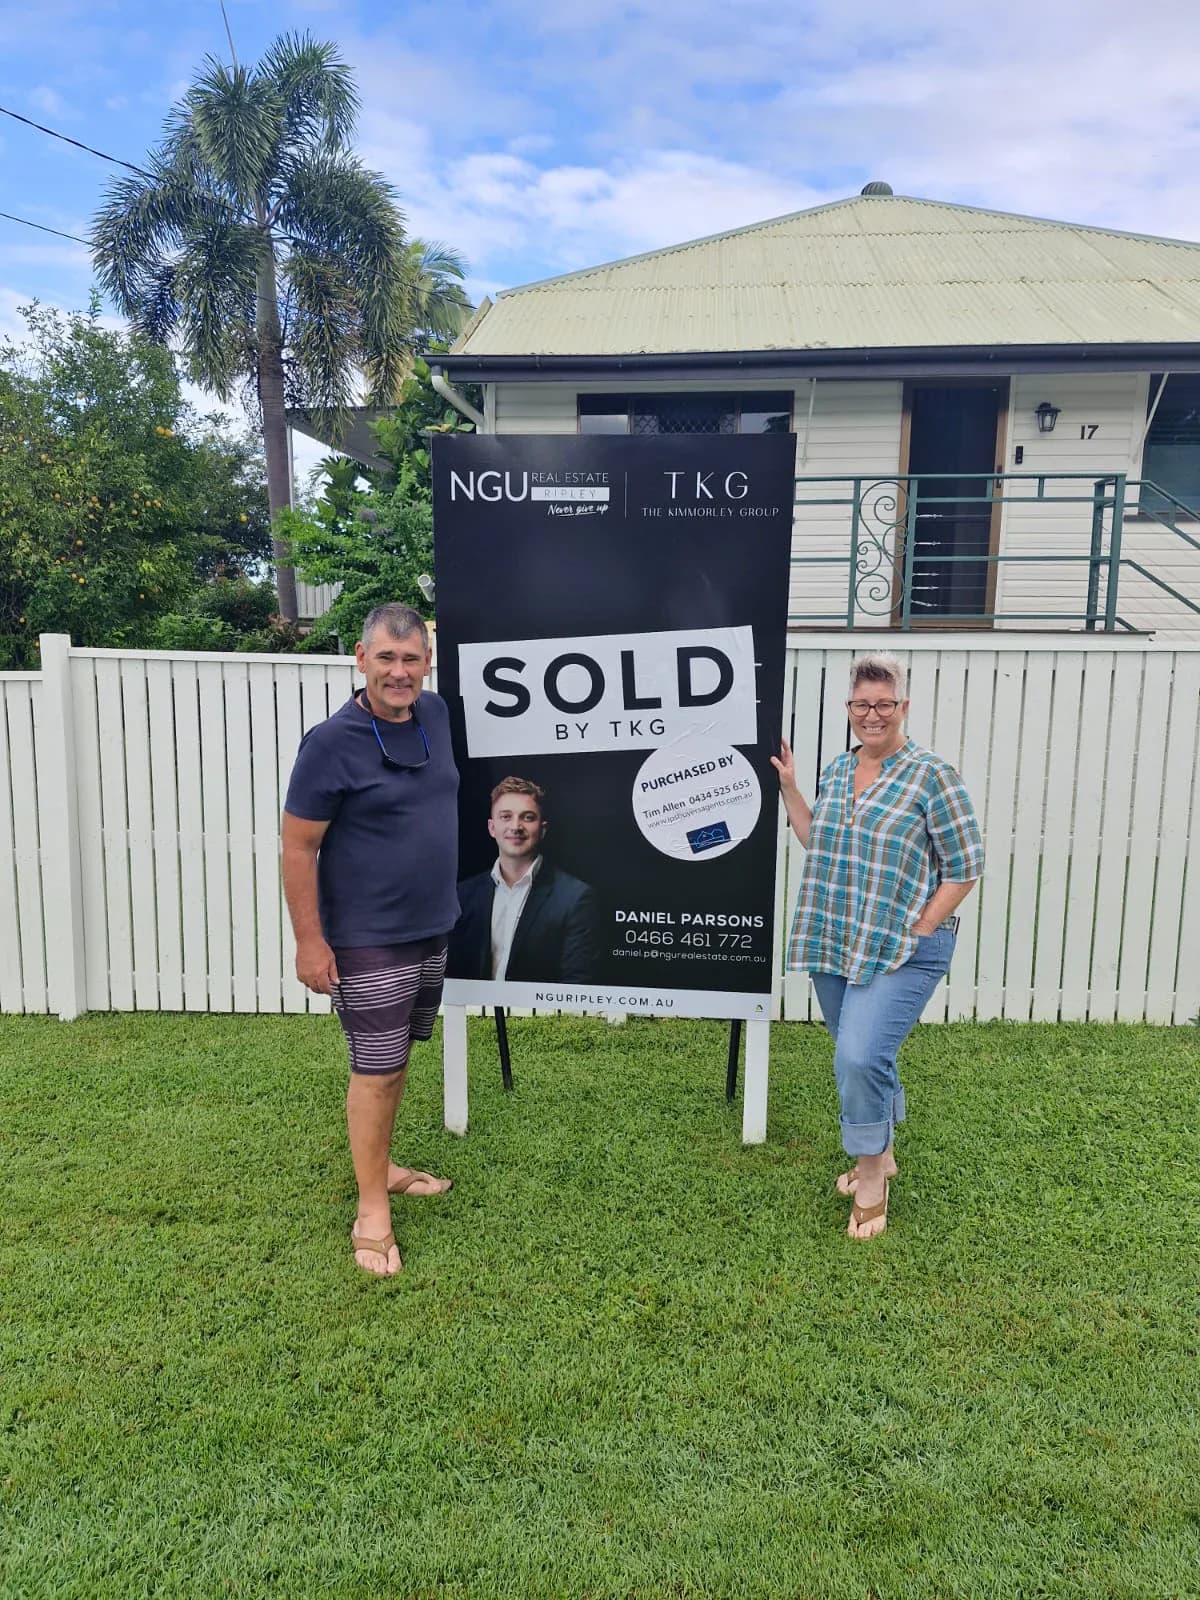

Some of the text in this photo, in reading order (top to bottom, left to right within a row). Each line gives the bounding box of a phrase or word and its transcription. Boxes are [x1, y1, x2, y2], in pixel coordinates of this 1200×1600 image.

[1081, 425, 1099, 440] 17
[450, 470, 528, 502] NGU
[532, 472, 608, 483] REAL ESTATE
[544, 488, 596, 499] RIPLEY
[548, 503, 609, 516] Never give up
[642, 507, 780, 518] THE KIMMORLEY GROUP
[482, 645, 735, 719] SOLD
[555, 718, 666, 741] BY TKG
[640, 754, 735, 793] PURCHASED BY
[643, 778, 751, 820] Tim Allen 0434 525 655
[615, 910, 765, 928] DANIEL PARSONS
[625, 929, 753, 949] 0466 461 772
[612, 948, 766, 963] daniel.p@ngurealestate.com.au
[535, 992, 675, 1008] NGURIPLEY.COM.AU
